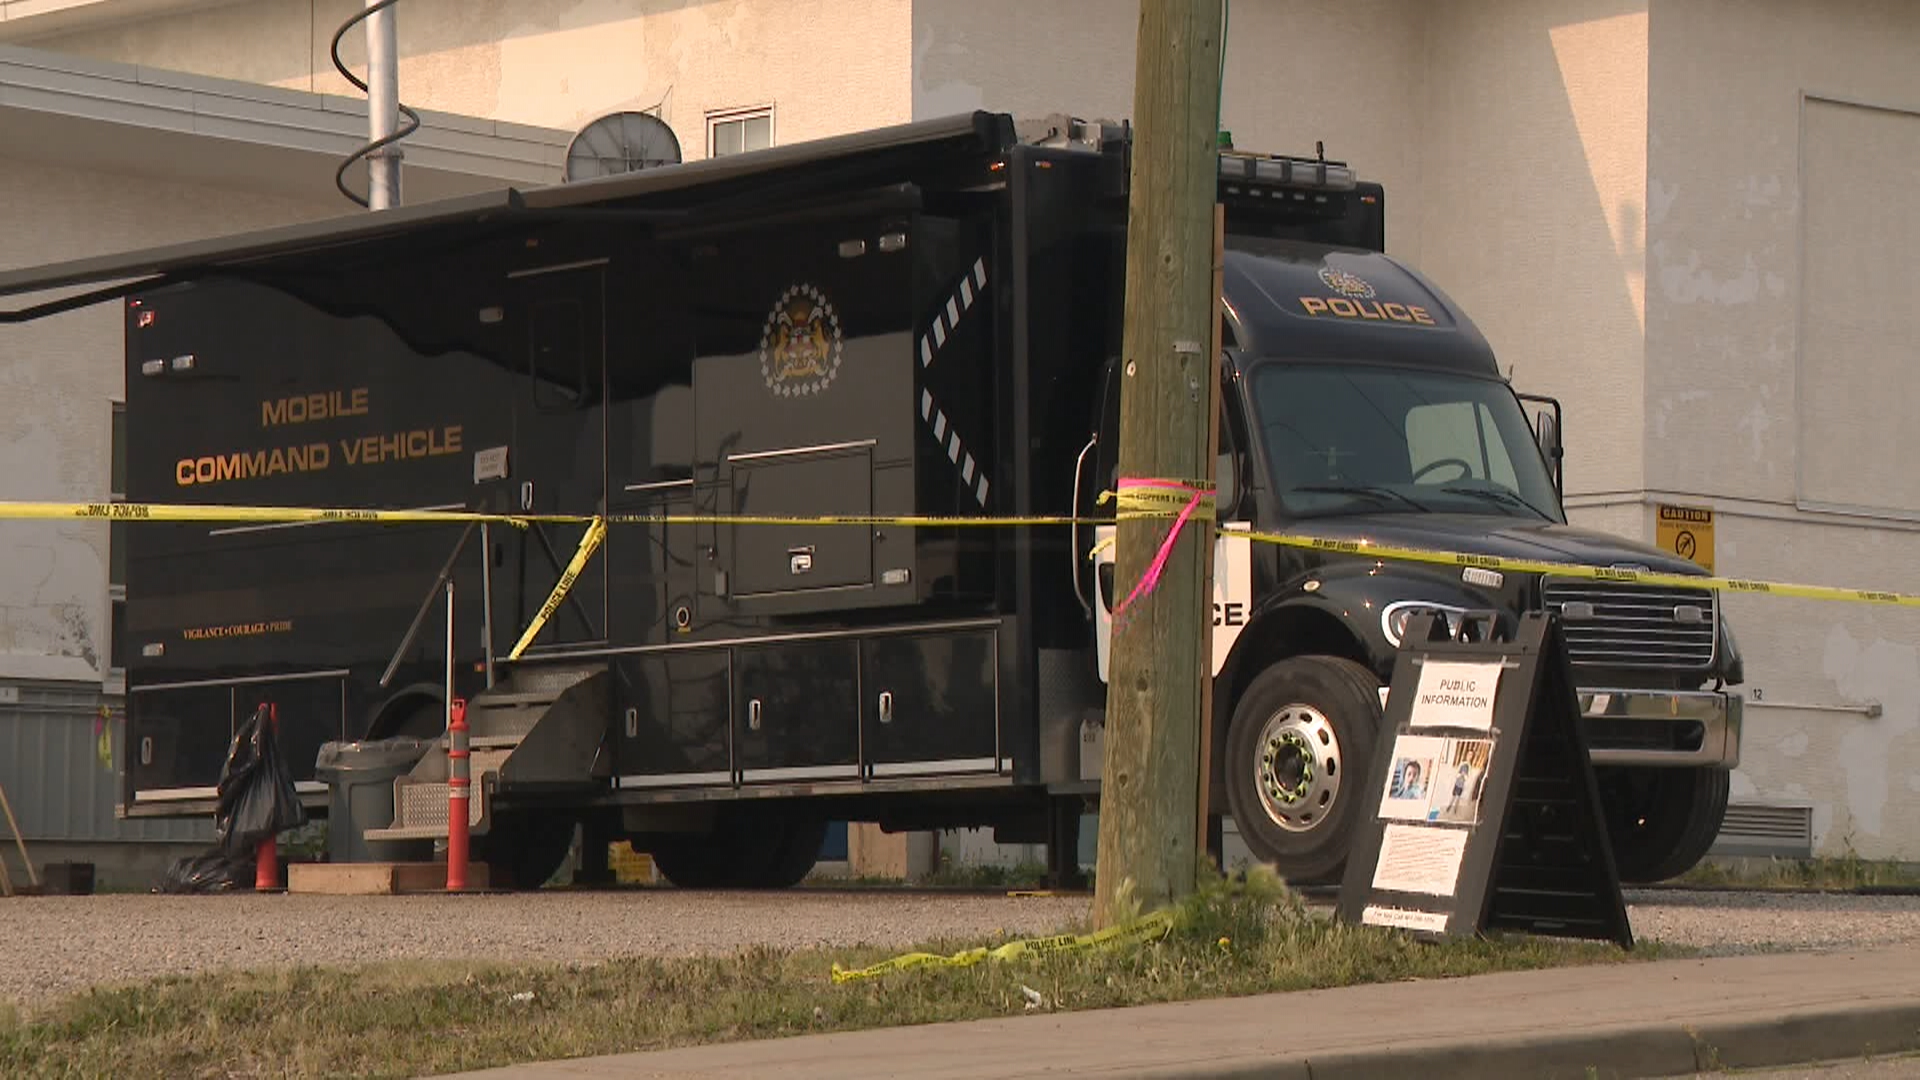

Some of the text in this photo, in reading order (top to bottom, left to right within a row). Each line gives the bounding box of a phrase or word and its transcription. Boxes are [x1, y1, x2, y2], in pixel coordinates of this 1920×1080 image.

[1299, 297, 1436, 325] POLICE
[262, 387, 369, 427] MOBILE
[176, 443, 330, 486] COMMAND
[340, 425, 463, 465] VEHICLE
[1663, 508, 1708, 521] CAUTION
[1324, 540, 1336, 549] NOT
[183, 620, 292, 640] VIGILANCE COURAGE PRIDE
[1440, 679, 1476, 692] PUBLIC
[1753, 688, 1763, 700] 12
[1421, 694, 1488, 708] INFORMATION
[1025, 938, 1057, 950] POLICE
